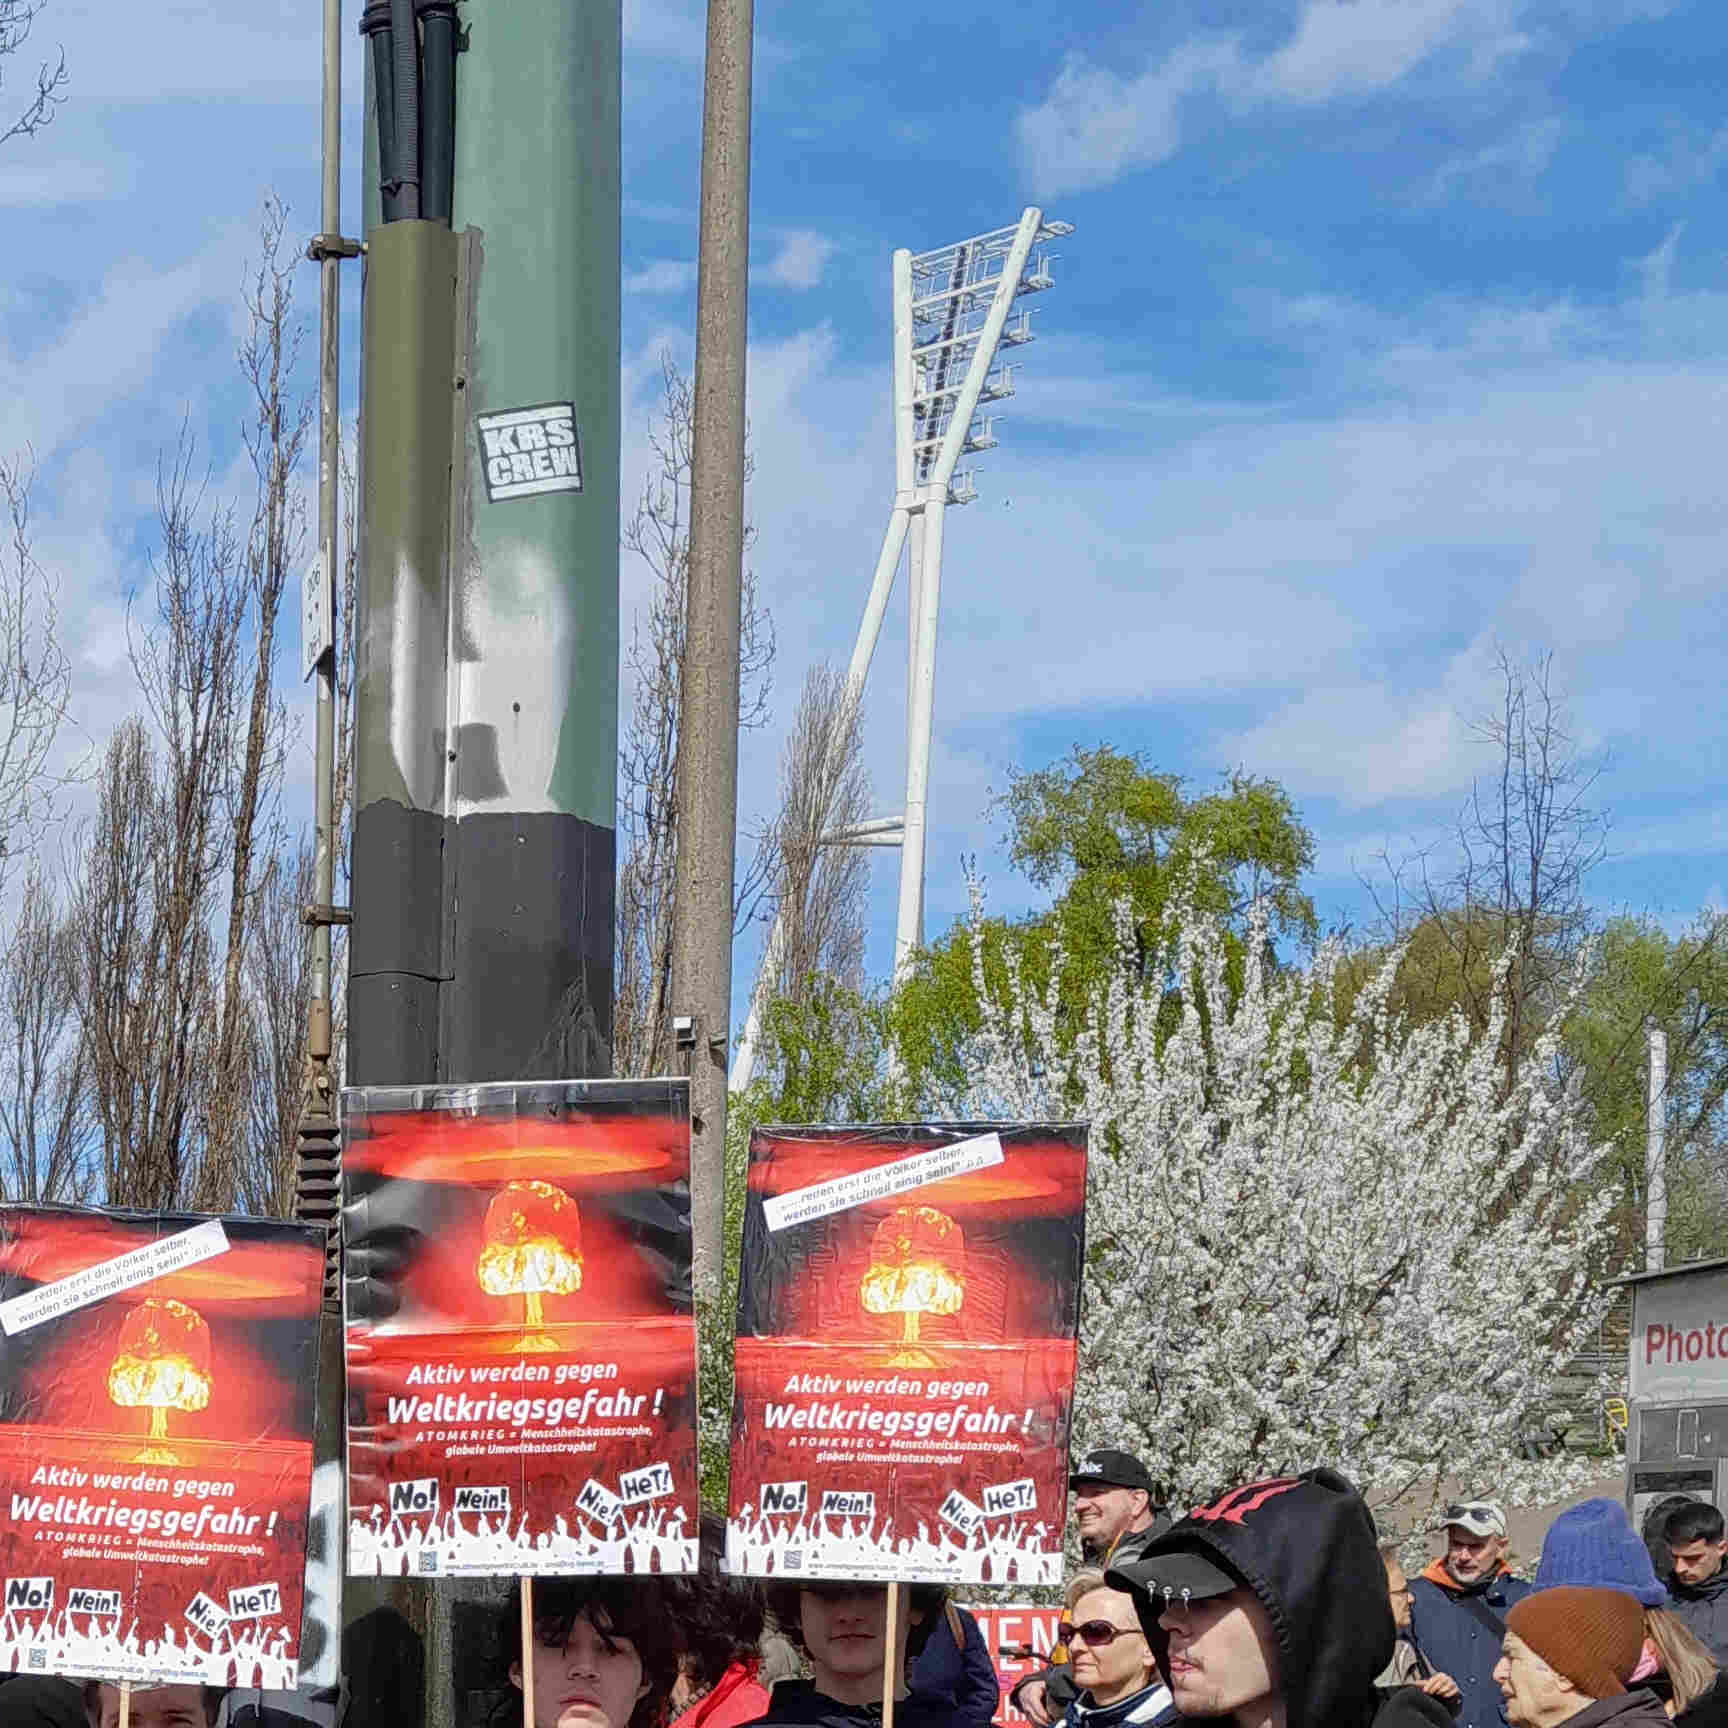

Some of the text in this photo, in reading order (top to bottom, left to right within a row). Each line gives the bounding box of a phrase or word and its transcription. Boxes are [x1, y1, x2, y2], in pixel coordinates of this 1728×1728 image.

[488, 446, 578, 485] CREW
[406, 1362, 617, 1384] Aktiv werden gegen
[784, 1375, 989, 1399] Aktiv werden gegen
[416, 1429, 505, 1442] ATOMKRIEG
[788, 1437, 874, 1449] ATOMKRIEG
[445, 1442, 597, 1458] globale Umweltkatastrophe!
[816, 1451, 854, 1464] globale
[31, 1466, 234, 1499] Aktiv werden gegen
[392, 1482, 437, 1510] No!
[456, 1488, 507, 1510] Nein!
[580, 1486, 619, 1524] Nie!
[762, 1484, 806, 1511] No!
[823, 1493, 872, 1514] Nein!
[943, 1498, 982, 1534] Nie!
[35, 1530, 121, 1545] ATOMKRIEG
[62, 1546, 101, 1560] globale
[8, 1580, 52, 1608] No!
[71, 1591, 119, 1613] Nein!
[189, 1601, 230, 1637] Nie!
